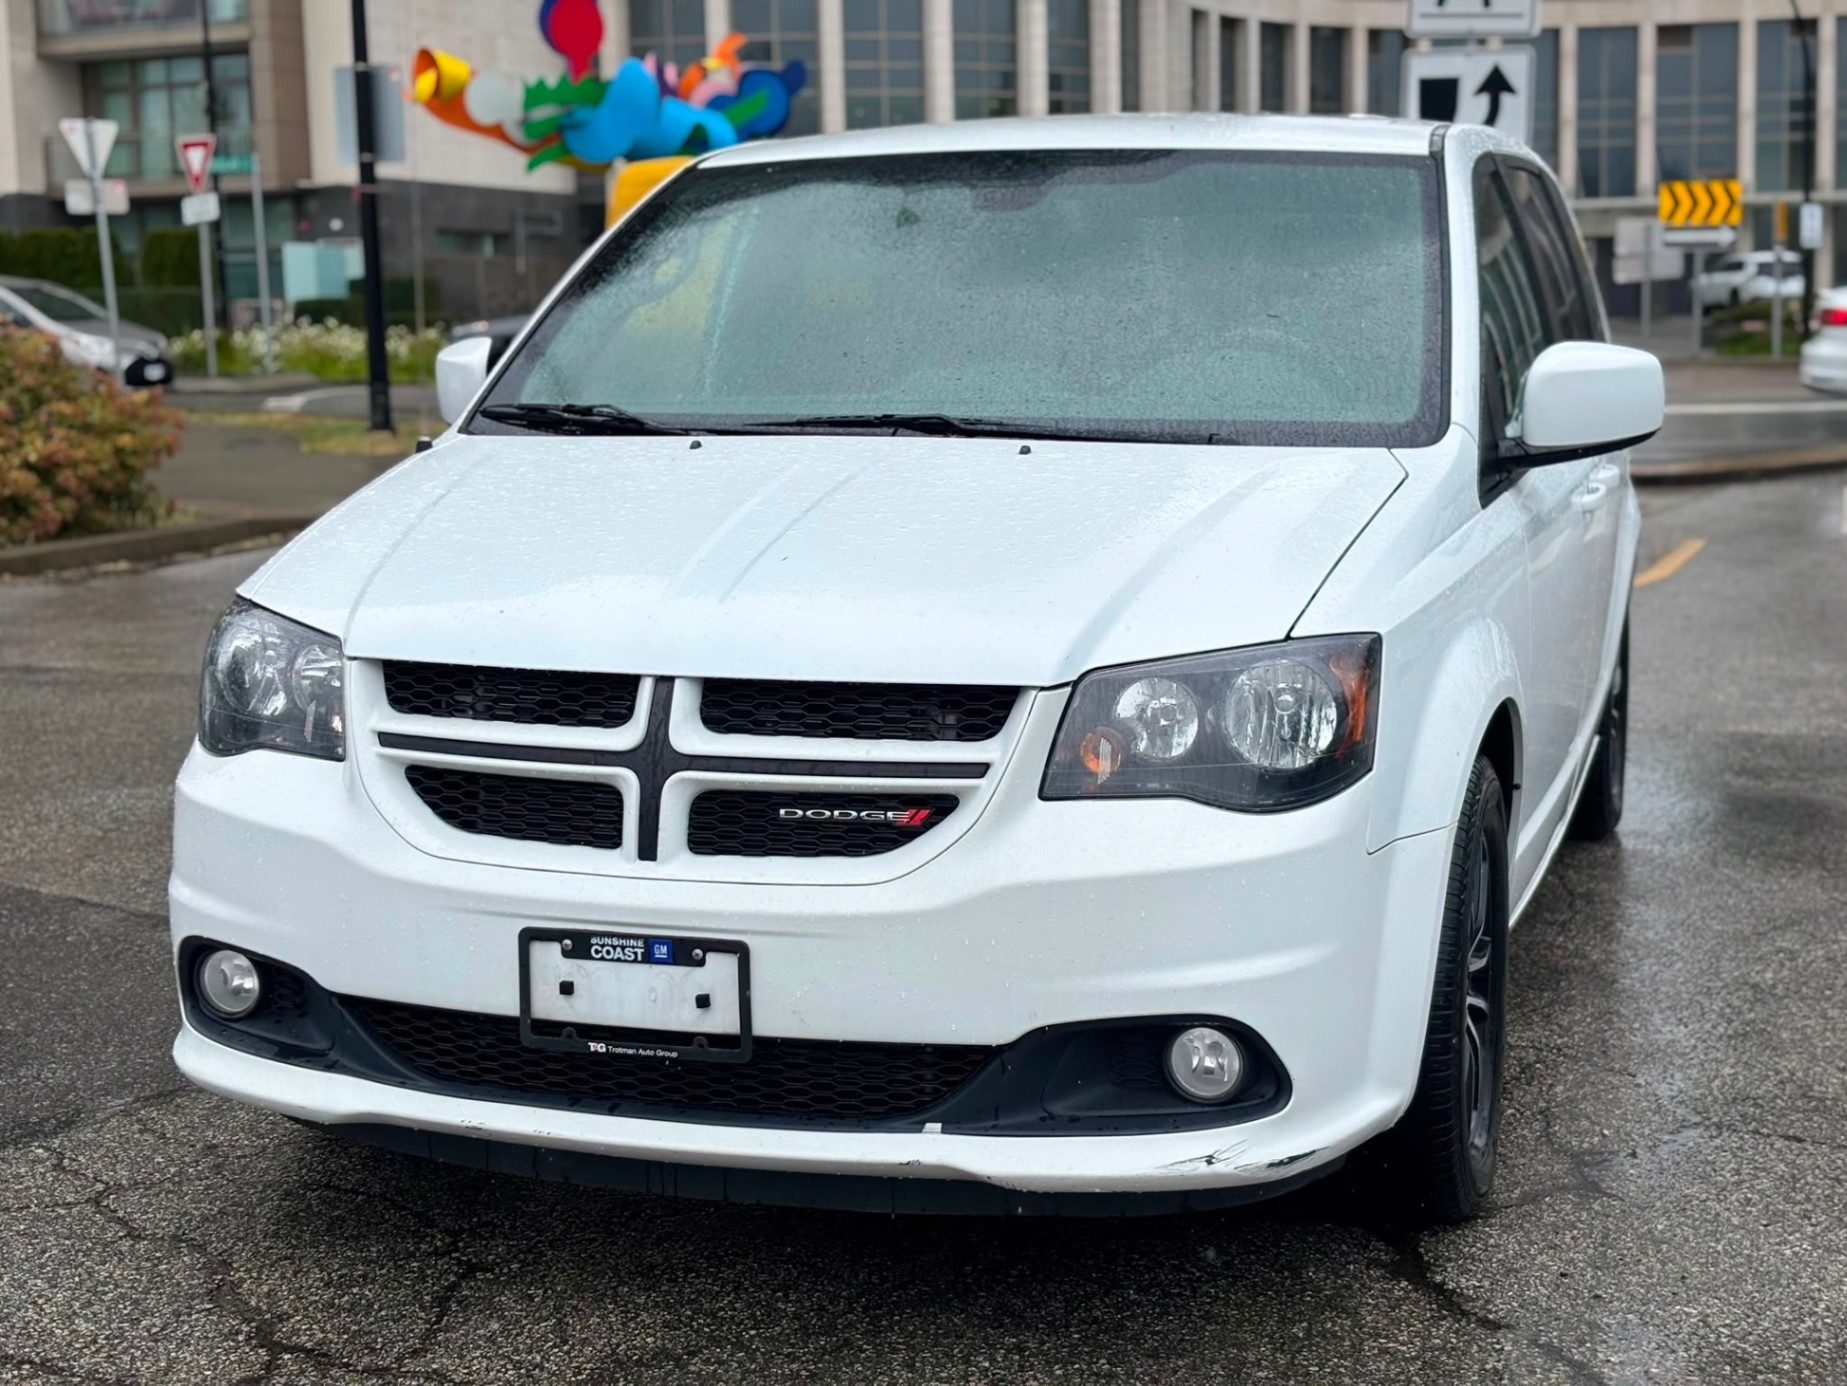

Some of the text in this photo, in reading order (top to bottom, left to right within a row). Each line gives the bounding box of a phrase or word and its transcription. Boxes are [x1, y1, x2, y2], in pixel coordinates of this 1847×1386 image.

[779, 808, 911, 822] DODGE
[590, 936, 645, 947] SUNSHINE
[590, 945, 645, 961] COAST
[654, 944, 668, 956] GM
[608, 1045, 637, 1055] Trotman
[638, 1048, 655, 1056] Auto
[656, 1049, 678, 1058] Group
